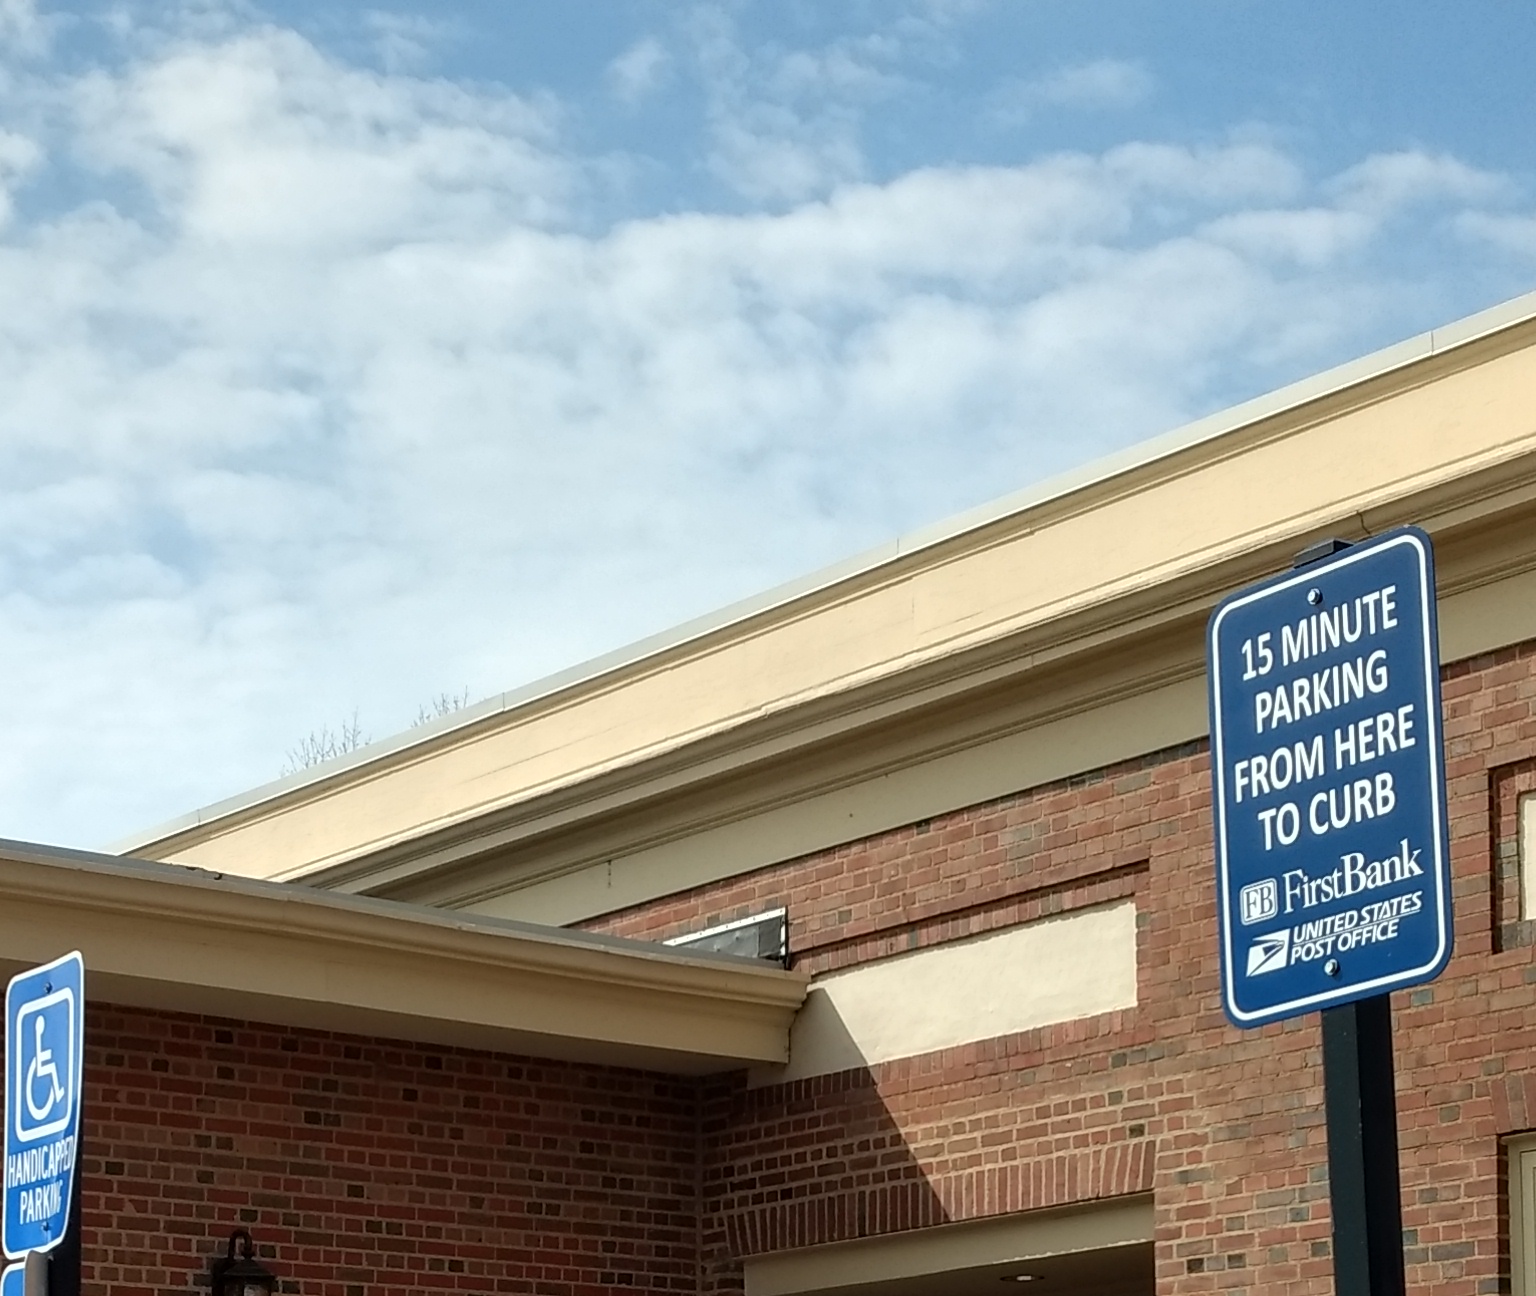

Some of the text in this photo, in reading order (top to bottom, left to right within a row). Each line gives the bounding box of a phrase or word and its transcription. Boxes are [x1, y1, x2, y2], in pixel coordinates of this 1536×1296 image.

[1241, 585, 1398, 681] 15 MINUTE
[1255, 649, 1388, 734] PARKING
[1234, 704, 1415, 803] FROM HERE
[1258, 772, 1396, 851] TO CURB
[1243, 838, 1424, 921] FB FirstBank
[1293, 891, 1423, 943] UNITED STATES
[1290, 919, 1399, 966] POST OFFICE
[8, 1135, 73, 1189] HANDICAPPED
[20, 1179, 63, 1225] PARKING
